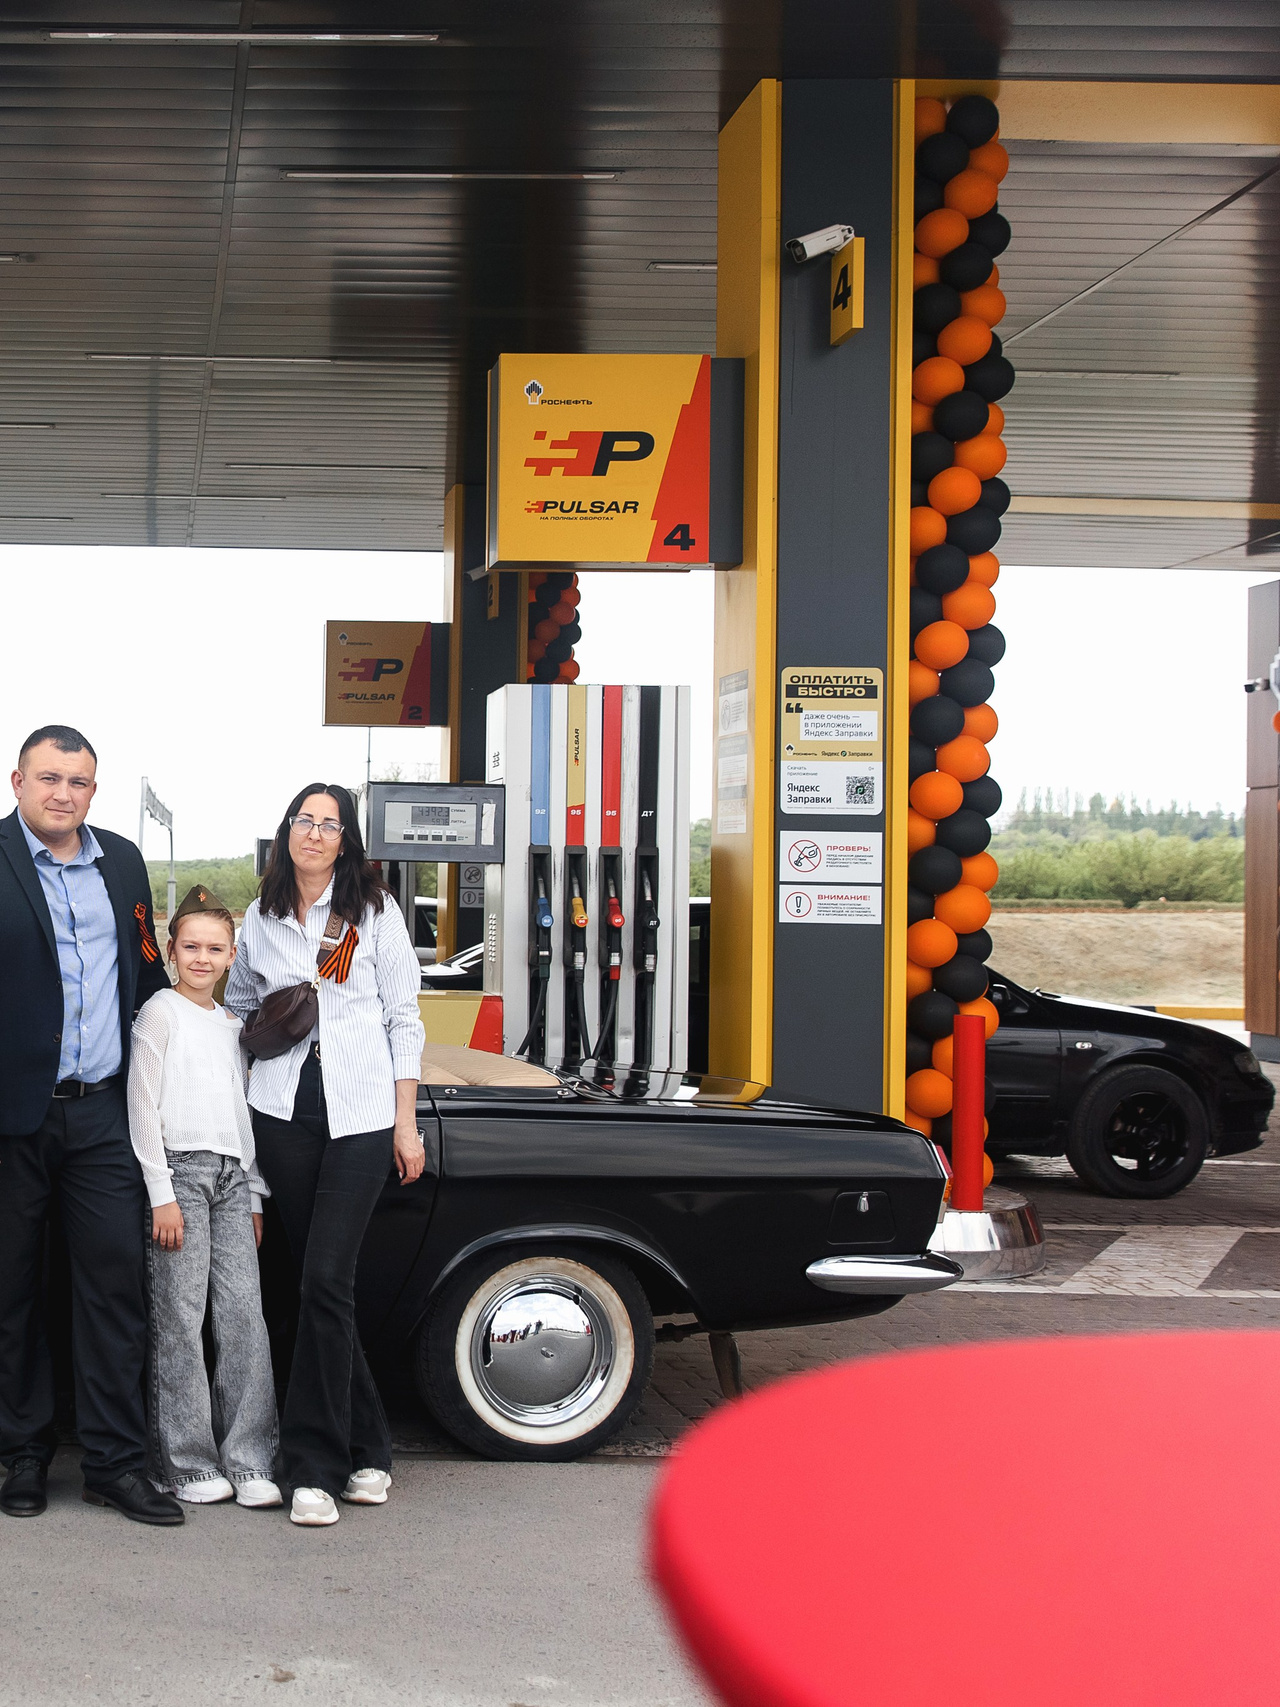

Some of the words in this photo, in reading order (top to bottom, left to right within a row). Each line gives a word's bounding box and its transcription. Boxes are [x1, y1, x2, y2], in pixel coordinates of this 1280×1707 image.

[833, 263, 851, 311] 4
[542, 500, 639, 513] PULSAR
[663, 524, 695, 550] 4
[790, 675, 874, 684] ОПЛАТИТЬ
[798, 687, 865, 696] БЫСТРО
[408, 706, 422, 720] 2
[787, 783, 820, 792] Яндекс
[787, 794, 832, 804] Заправки
